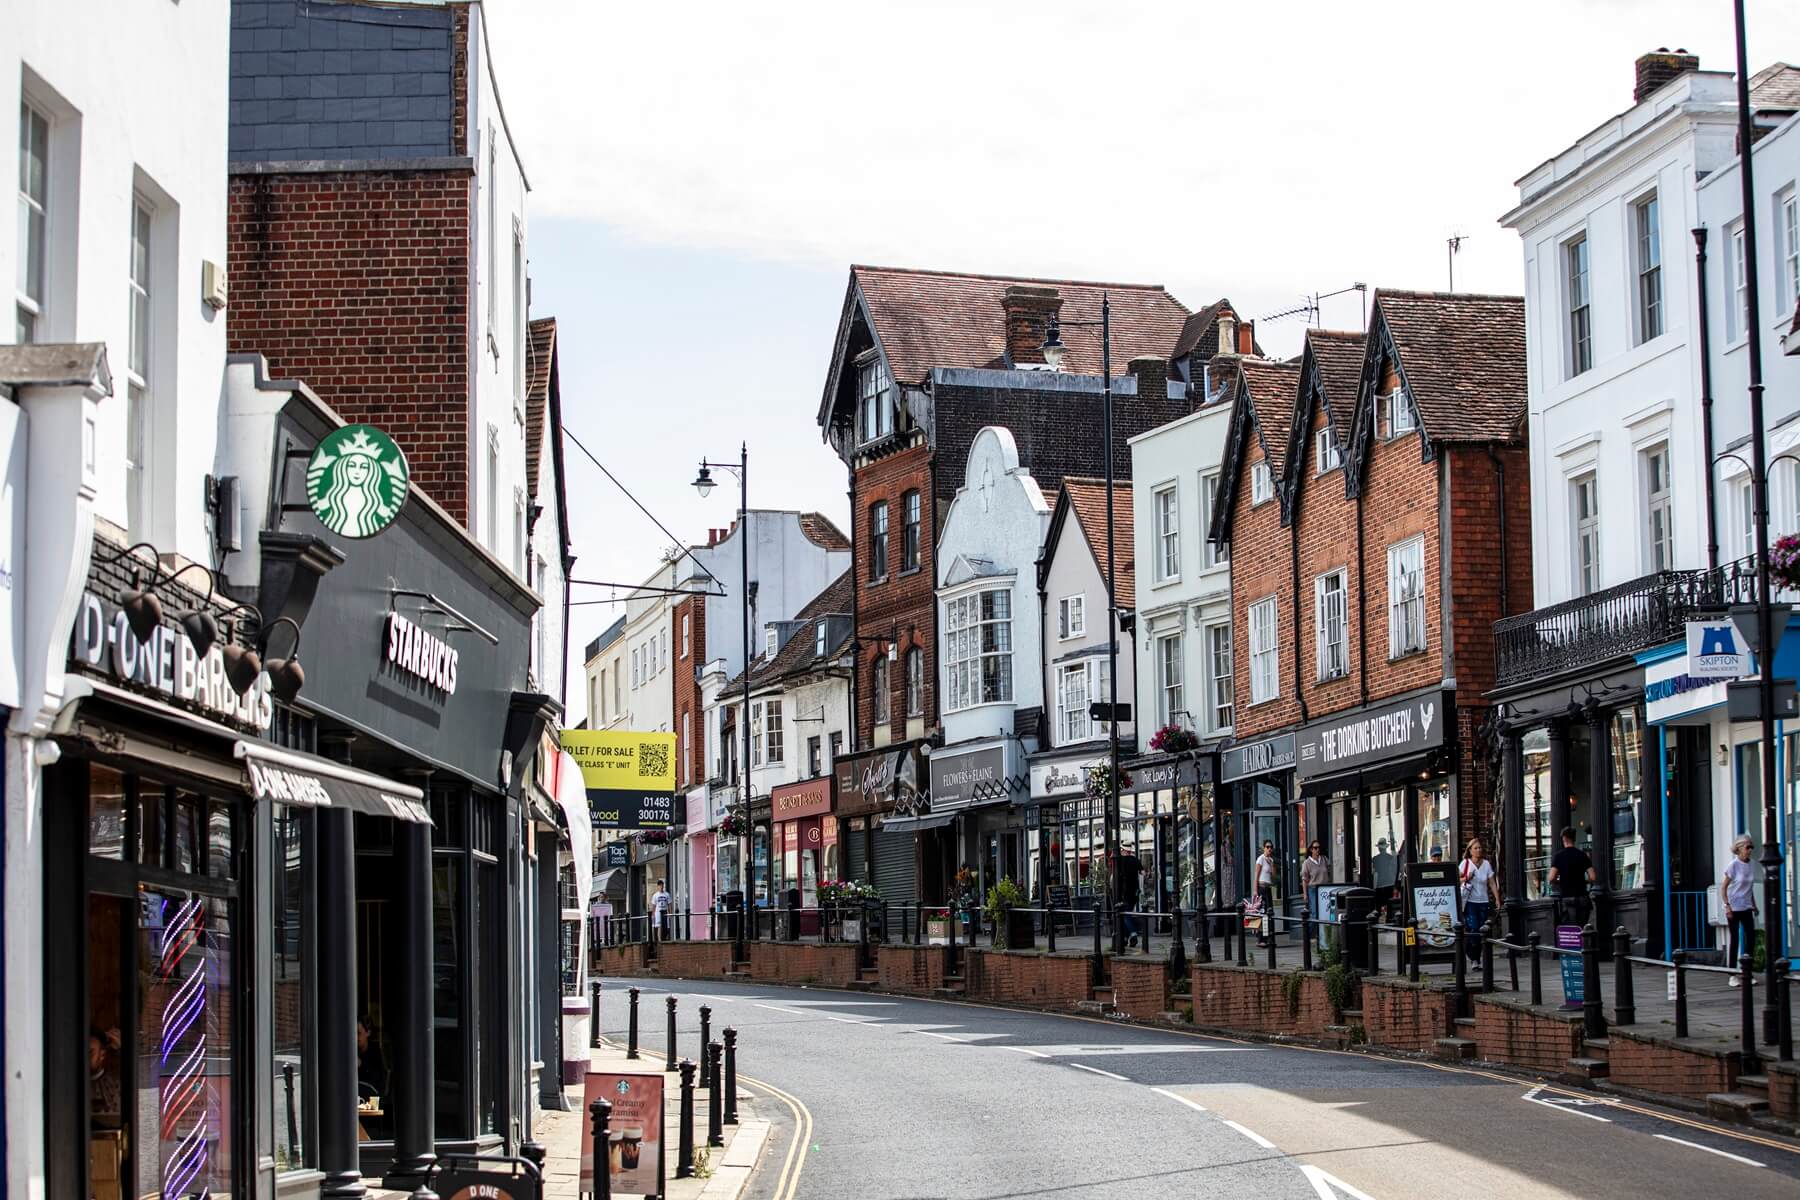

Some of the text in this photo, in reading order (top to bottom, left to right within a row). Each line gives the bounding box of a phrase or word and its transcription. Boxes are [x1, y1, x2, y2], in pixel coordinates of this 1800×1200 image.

[76, 592, 175, 693] D-ONE
[388, 611, 458, 695] STARBUCKS
[1700, 656, 1739, 666] SKIPTON
[1322, 708, 1412, 763] THE DORKING BUTCHERY
[563, 746, 574, 755] TO
[576, 746, 590, 755] LET
[597, 747, 613, 757] FOR
[614, 747, 634, 757] SALE
[585, 760, 605, 768] CLASS
[606, 761, 615, 769] "E"
[943, 770, 968, 787] FLOWERS
[973, 766, 993, 782] ELAINE
[643, 796, 670, 808] 01483
[638, 809, 670, 821] 300176
[1417, 888, 1437, 898] Fresh
[1424, 898, 1449, 910] delights
[469, 1185, 499, 1198] D ONE
